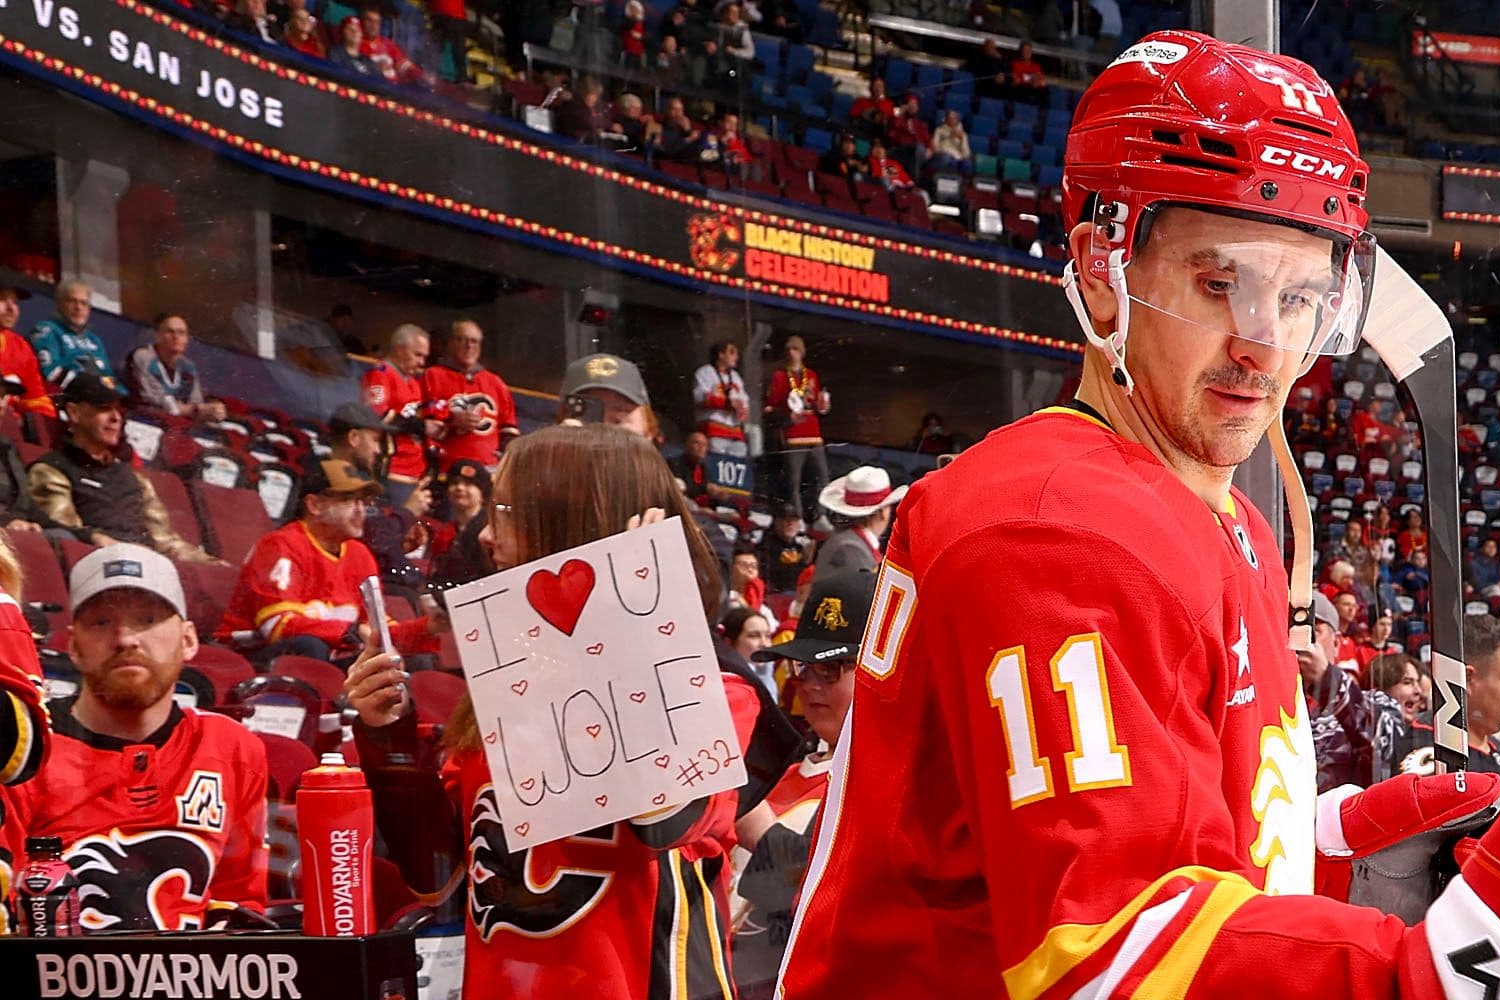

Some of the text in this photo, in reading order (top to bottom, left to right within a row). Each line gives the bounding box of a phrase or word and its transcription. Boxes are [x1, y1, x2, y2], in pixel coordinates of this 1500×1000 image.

[108, 30, 181, 85] SAN
[196, 70, 284, 129] JOSE
[1277, 76, 1324, 118] 11
[1260, 144, 1348, 181] CCM
[744, 222, 875, 272] BLACK HISTORY
[744, 247, 889, 304] CELEBRATION
[716, 460, 747, 486] 107
[270, 557, 292, 591] 4
[454, 538, 662, 680] I U
[814, 646, 849, 660] CCM
[497, 654, 703, 807] WOLF
[985, 631, 1133, 810] 11
[675, 739, 741, 789] #32
[176, 769, 226, 833] A
[351, 828, 360, 889] Sports Drink
[35, 954, 302, 1000] BODYARMOR
